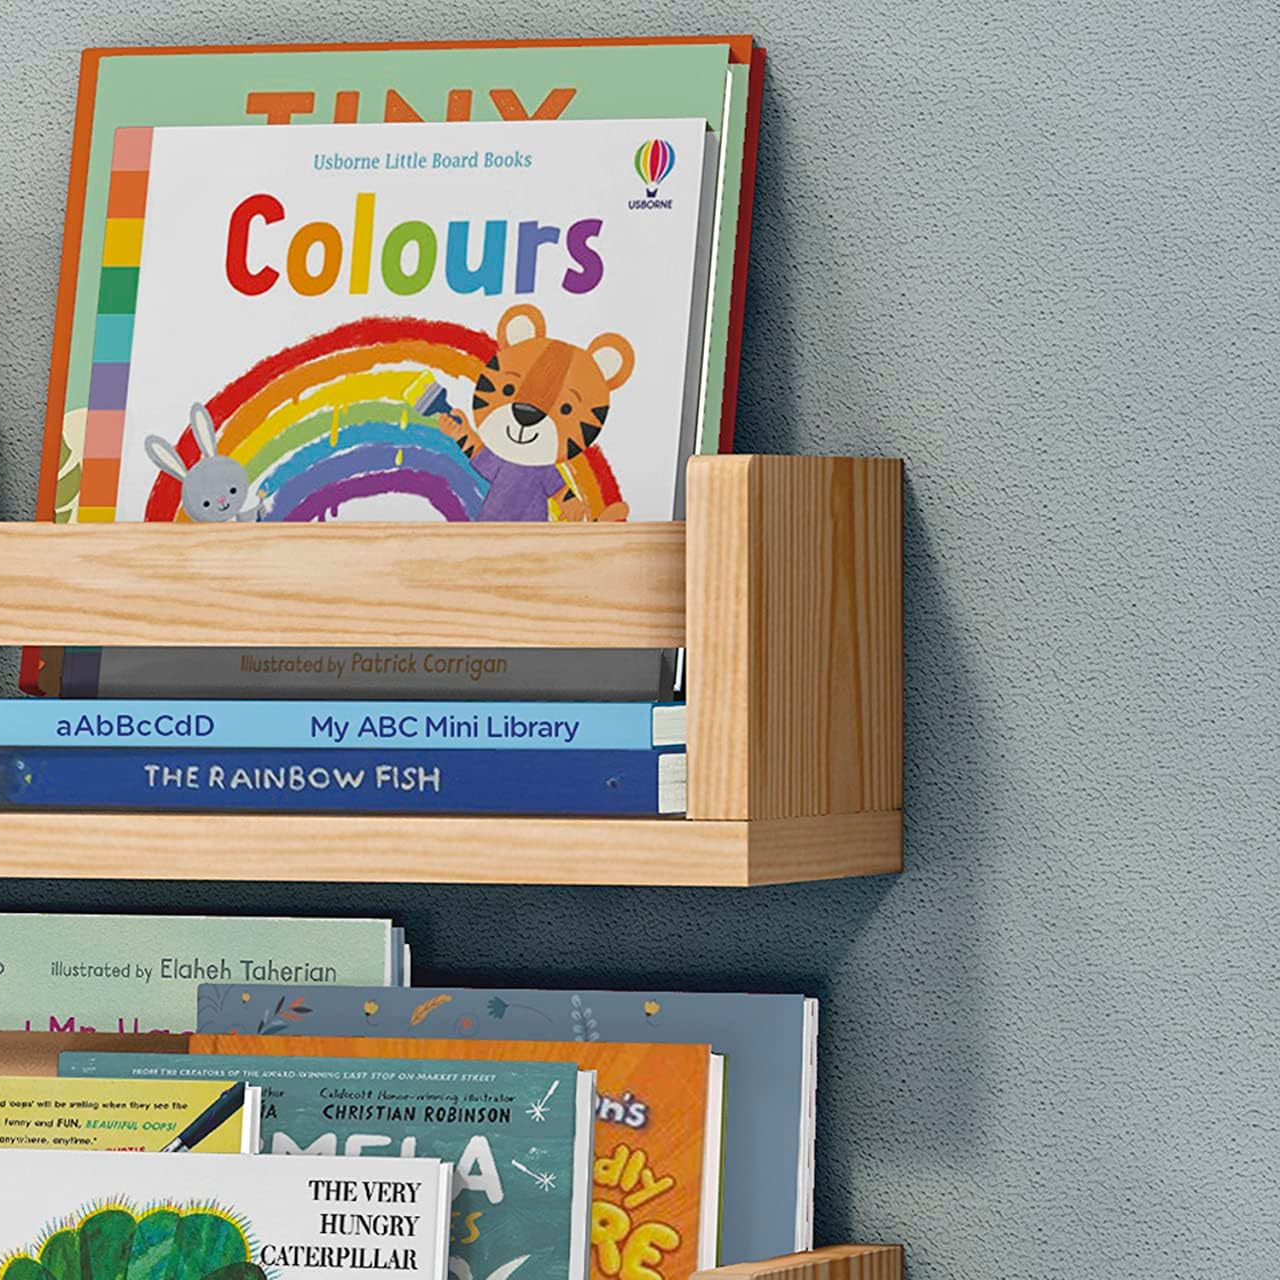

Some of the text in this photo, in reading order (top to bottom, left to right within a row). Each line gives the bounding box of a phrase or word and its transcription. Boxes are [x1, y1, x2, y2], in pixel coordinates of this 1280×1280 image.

[314, 151, 532, 170] Usborne Little Board Books
[628, 199, 673, 210] USBORNE
[225, 192, 604, 296] Colours
[240, 652, 507, 680] Illustrated by Patrick Corrigan
[57, 715, 580, 743] aAbBcCdD My ABC Mini Library
[144, 764, 441, 792] THE RAINBOW FISH
[51, 961, 130, 978] illustrated
[136, 964, 153, 983] by
[161, 958, 232, 980] Elaheh
[240, 960, 336, 982] Taherian
[343, 1072, 369, 1080] LAST
[370, 1072, 396, 1080] STOP
[398, 1073, 415, 1081] ON
[417, 1073, 458, 1081] MARKET
[460, 1074, 497, 1082] STREET
[320, 1087, 373, 1099] Caldecott
[37, 1100, 51, 1108] will
[55, 1100, 67, 1109] be
[70, 1101, 99, 1110] smiling
[102, 1101, 127, 1109] when
[130, 1101, 150, 1111] they
[172, 1102, 188, 1110] the
[322, 1104, 511, 1124] CHRISTIAN ROBINSON
[4, 1118, 32, 1128] funny
[35, 1119, 53, 1128] and
[86, 1120, 138, 1130] BEAUTIFUL
[143, 1122, 177, 1132] OOPS!
[308, 1180, 423, 1203] THE VERY
[320, 1213, 420, 1237] HUNGRY
[260, 1244, 419, 1271] CATERPILLAR
